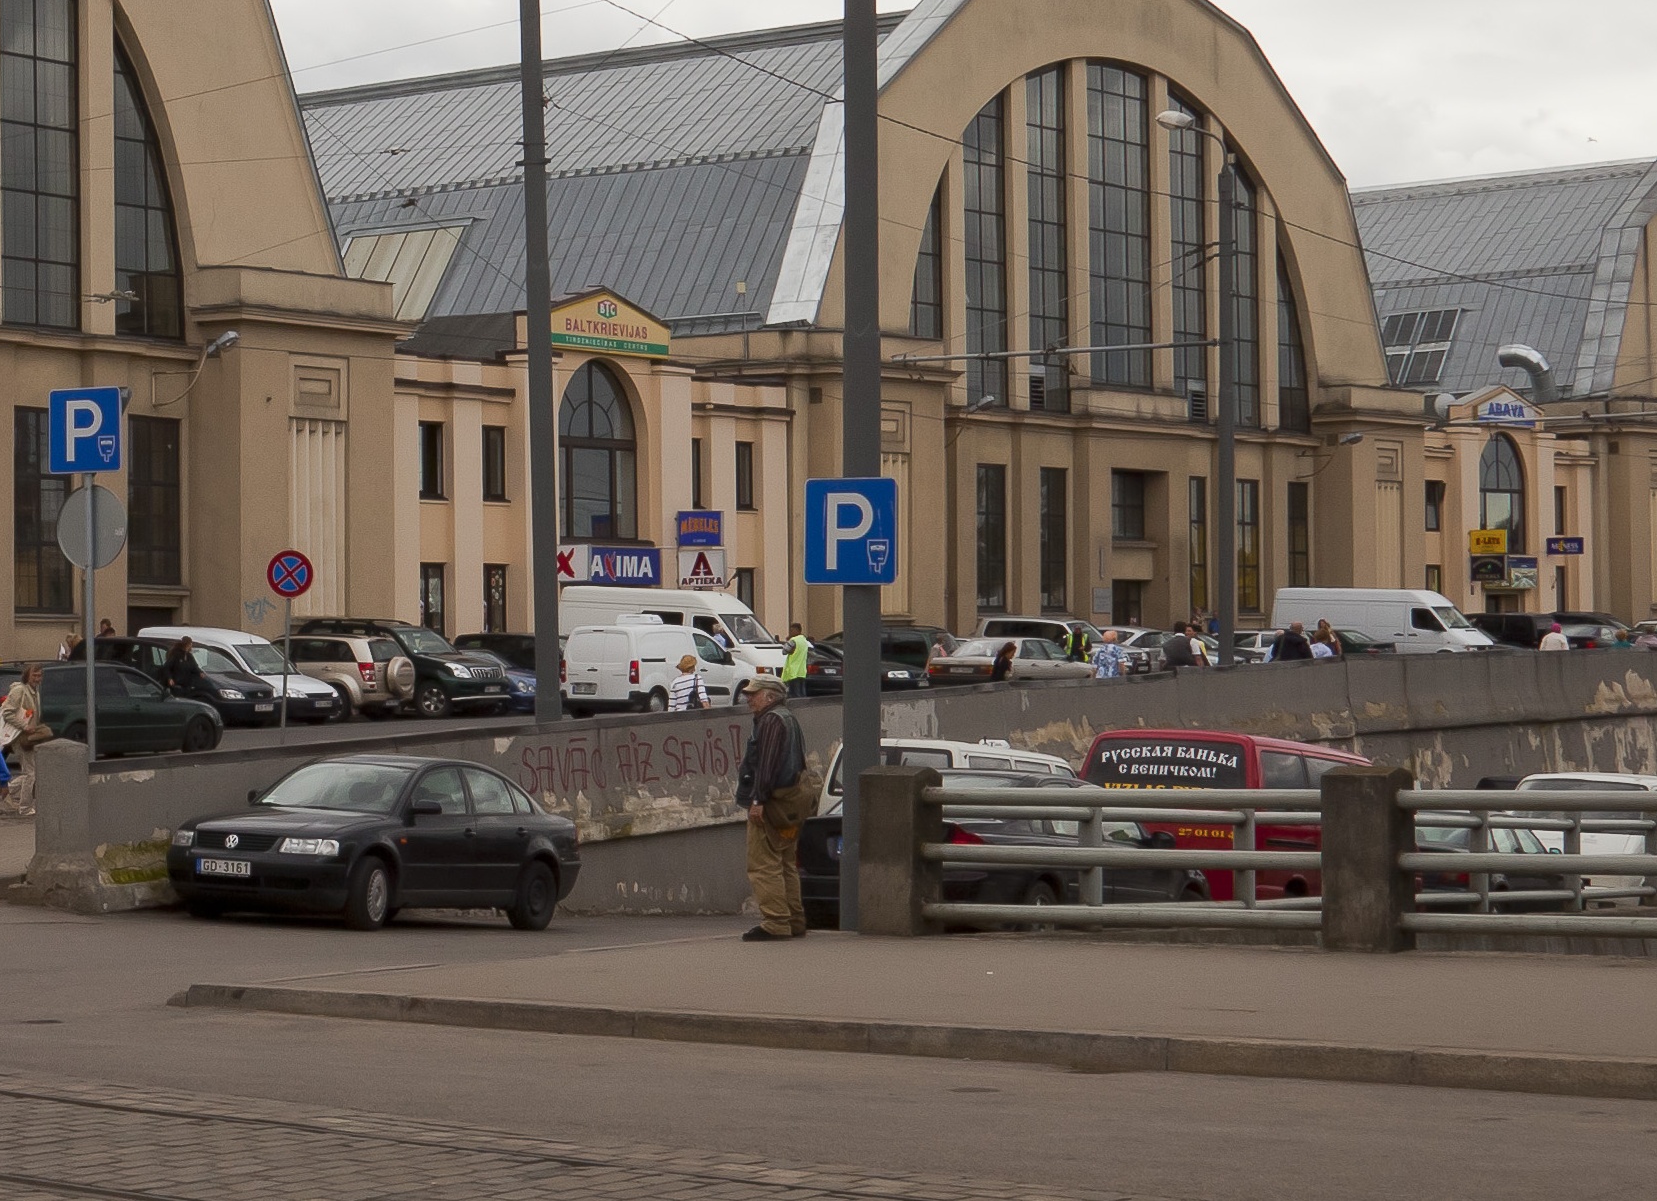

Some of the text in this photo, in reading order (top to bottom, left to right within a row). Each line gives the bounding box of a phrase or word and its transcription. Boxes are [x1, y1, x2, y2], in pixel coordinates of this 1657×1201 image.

[599, 300, 616, 317] BTC
[565, 317, 648, 339] BALTKRIEVIJAS
[1487, 401, 1526, 419] ABAVA
[66, 399, 103, 462] P
[826, 492, 874, 570] P
[681, 576, 723, 586] APTIEKA
[1101, 745, 1238, 769] РУССКАЯ БАНЬКА
